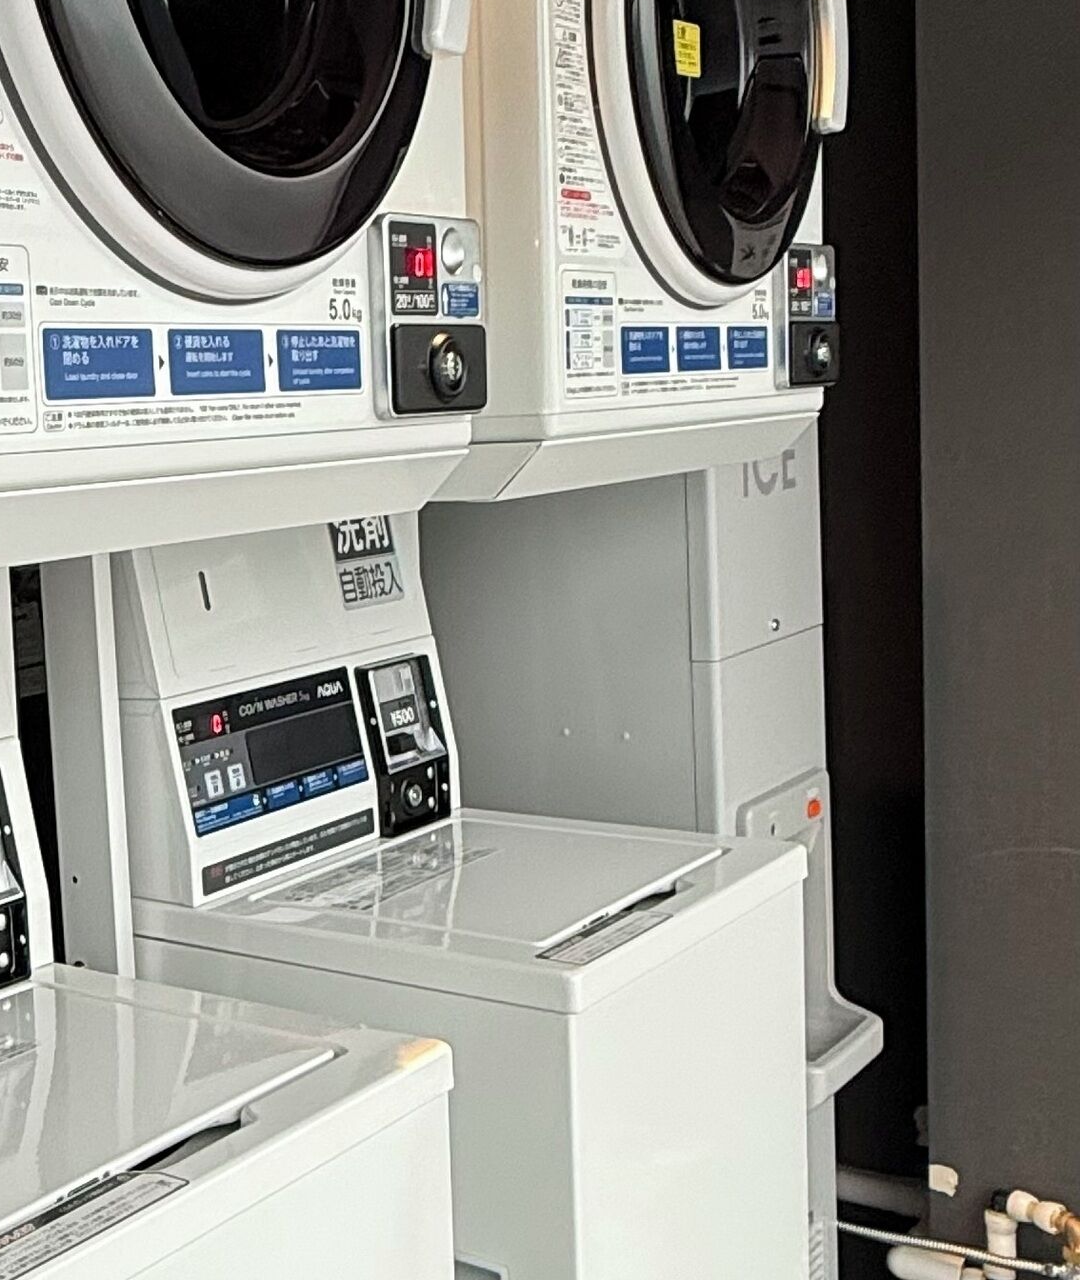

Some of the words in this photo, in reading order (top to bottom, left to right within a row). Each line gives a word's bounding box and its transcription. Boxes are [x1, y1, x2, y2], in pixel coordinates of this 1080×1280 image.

[339, 561, 403, 603] 自動投入
[264, 692, 298, 710] WASHER
[317, 680, 344, 699] AQUA
[390, 706, 415, 727] ¥500
